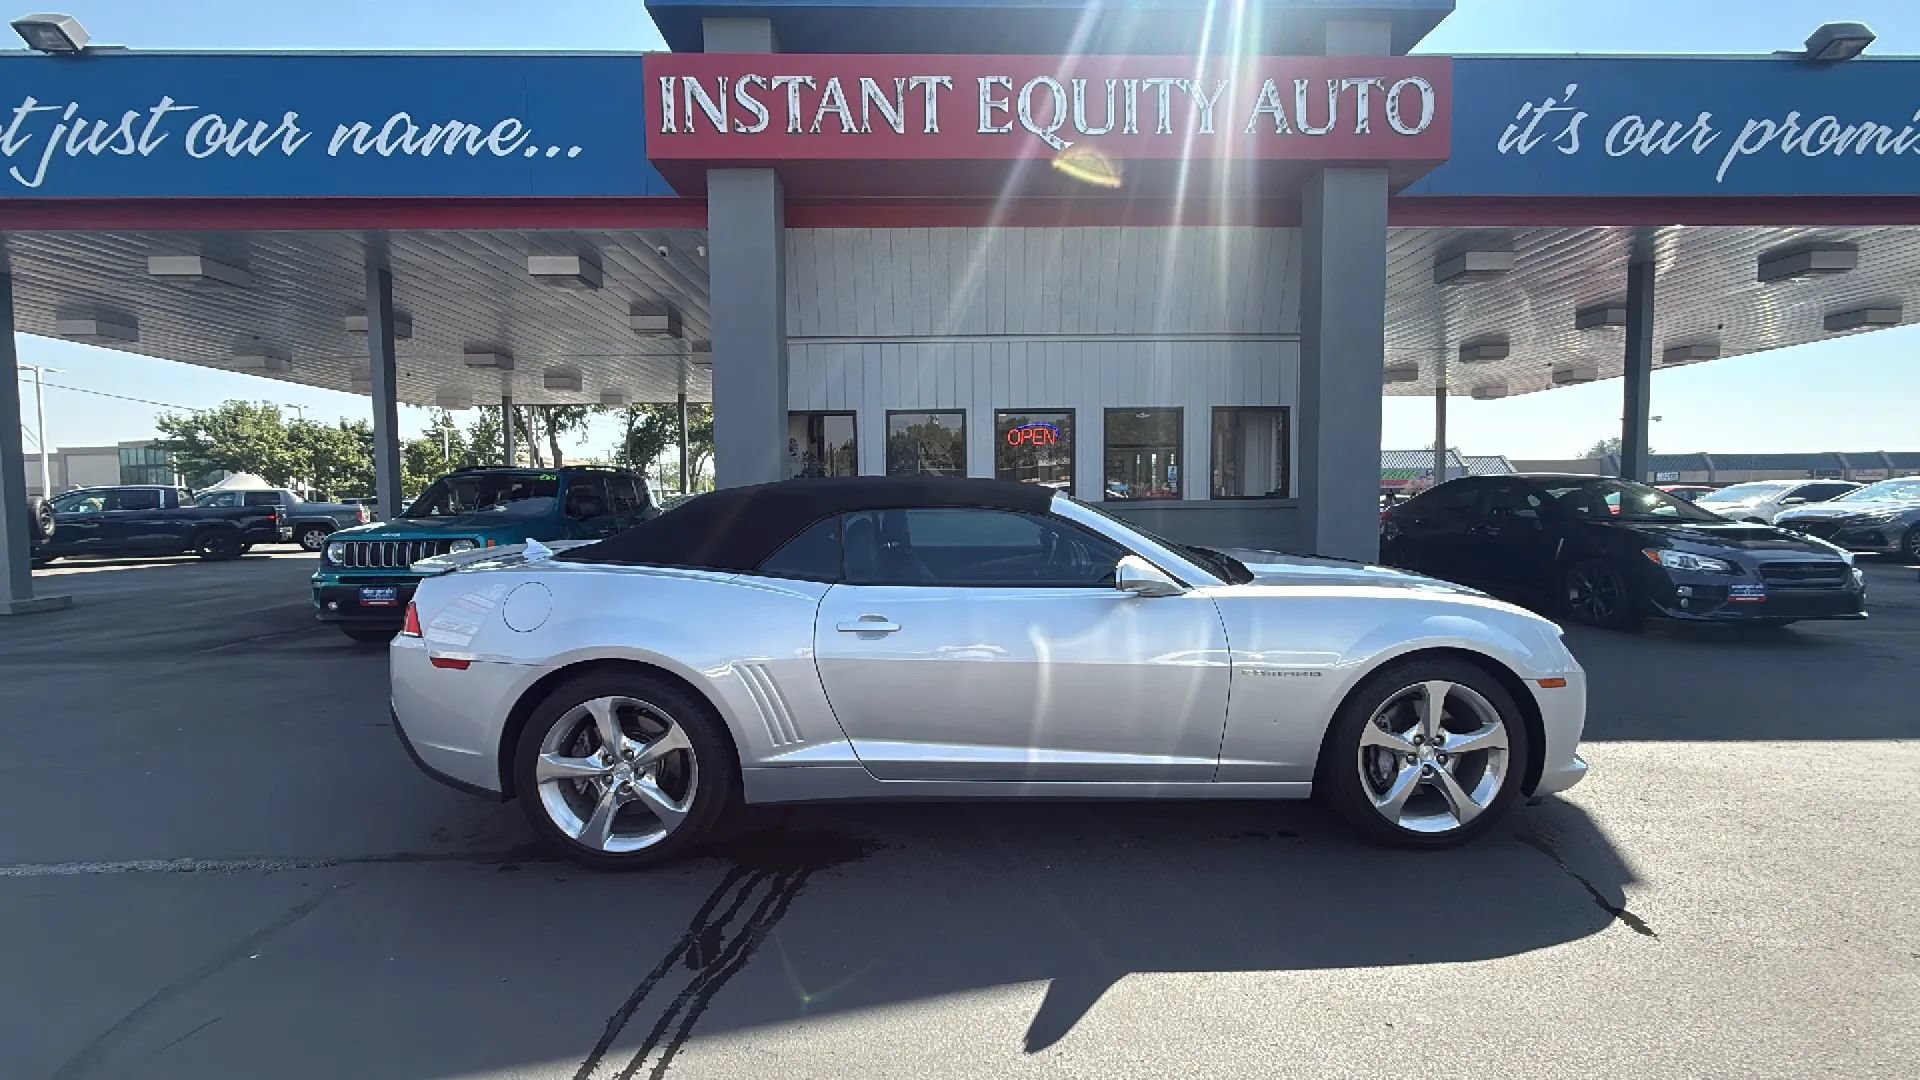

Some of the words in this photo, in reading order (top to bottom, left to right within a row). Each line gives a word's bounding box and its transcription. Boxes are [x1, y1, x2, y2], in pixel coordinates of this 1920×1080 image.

[10, 96, 198, 187] just
[186, 111, 312, 158] our
[328, 111, 582, 158] name...
[659, 74, 952, 135] INSTANT
[976, 75, 1229, 151] EQUITY
[1244, 77, 1434, 136] AUTO
[1498, 84, 1589, 155] it's
[1605, 111, 1721, 157] our
[1716, 111, 1920, 183] promi
[1007, 427, 1057, 446] OPEN
